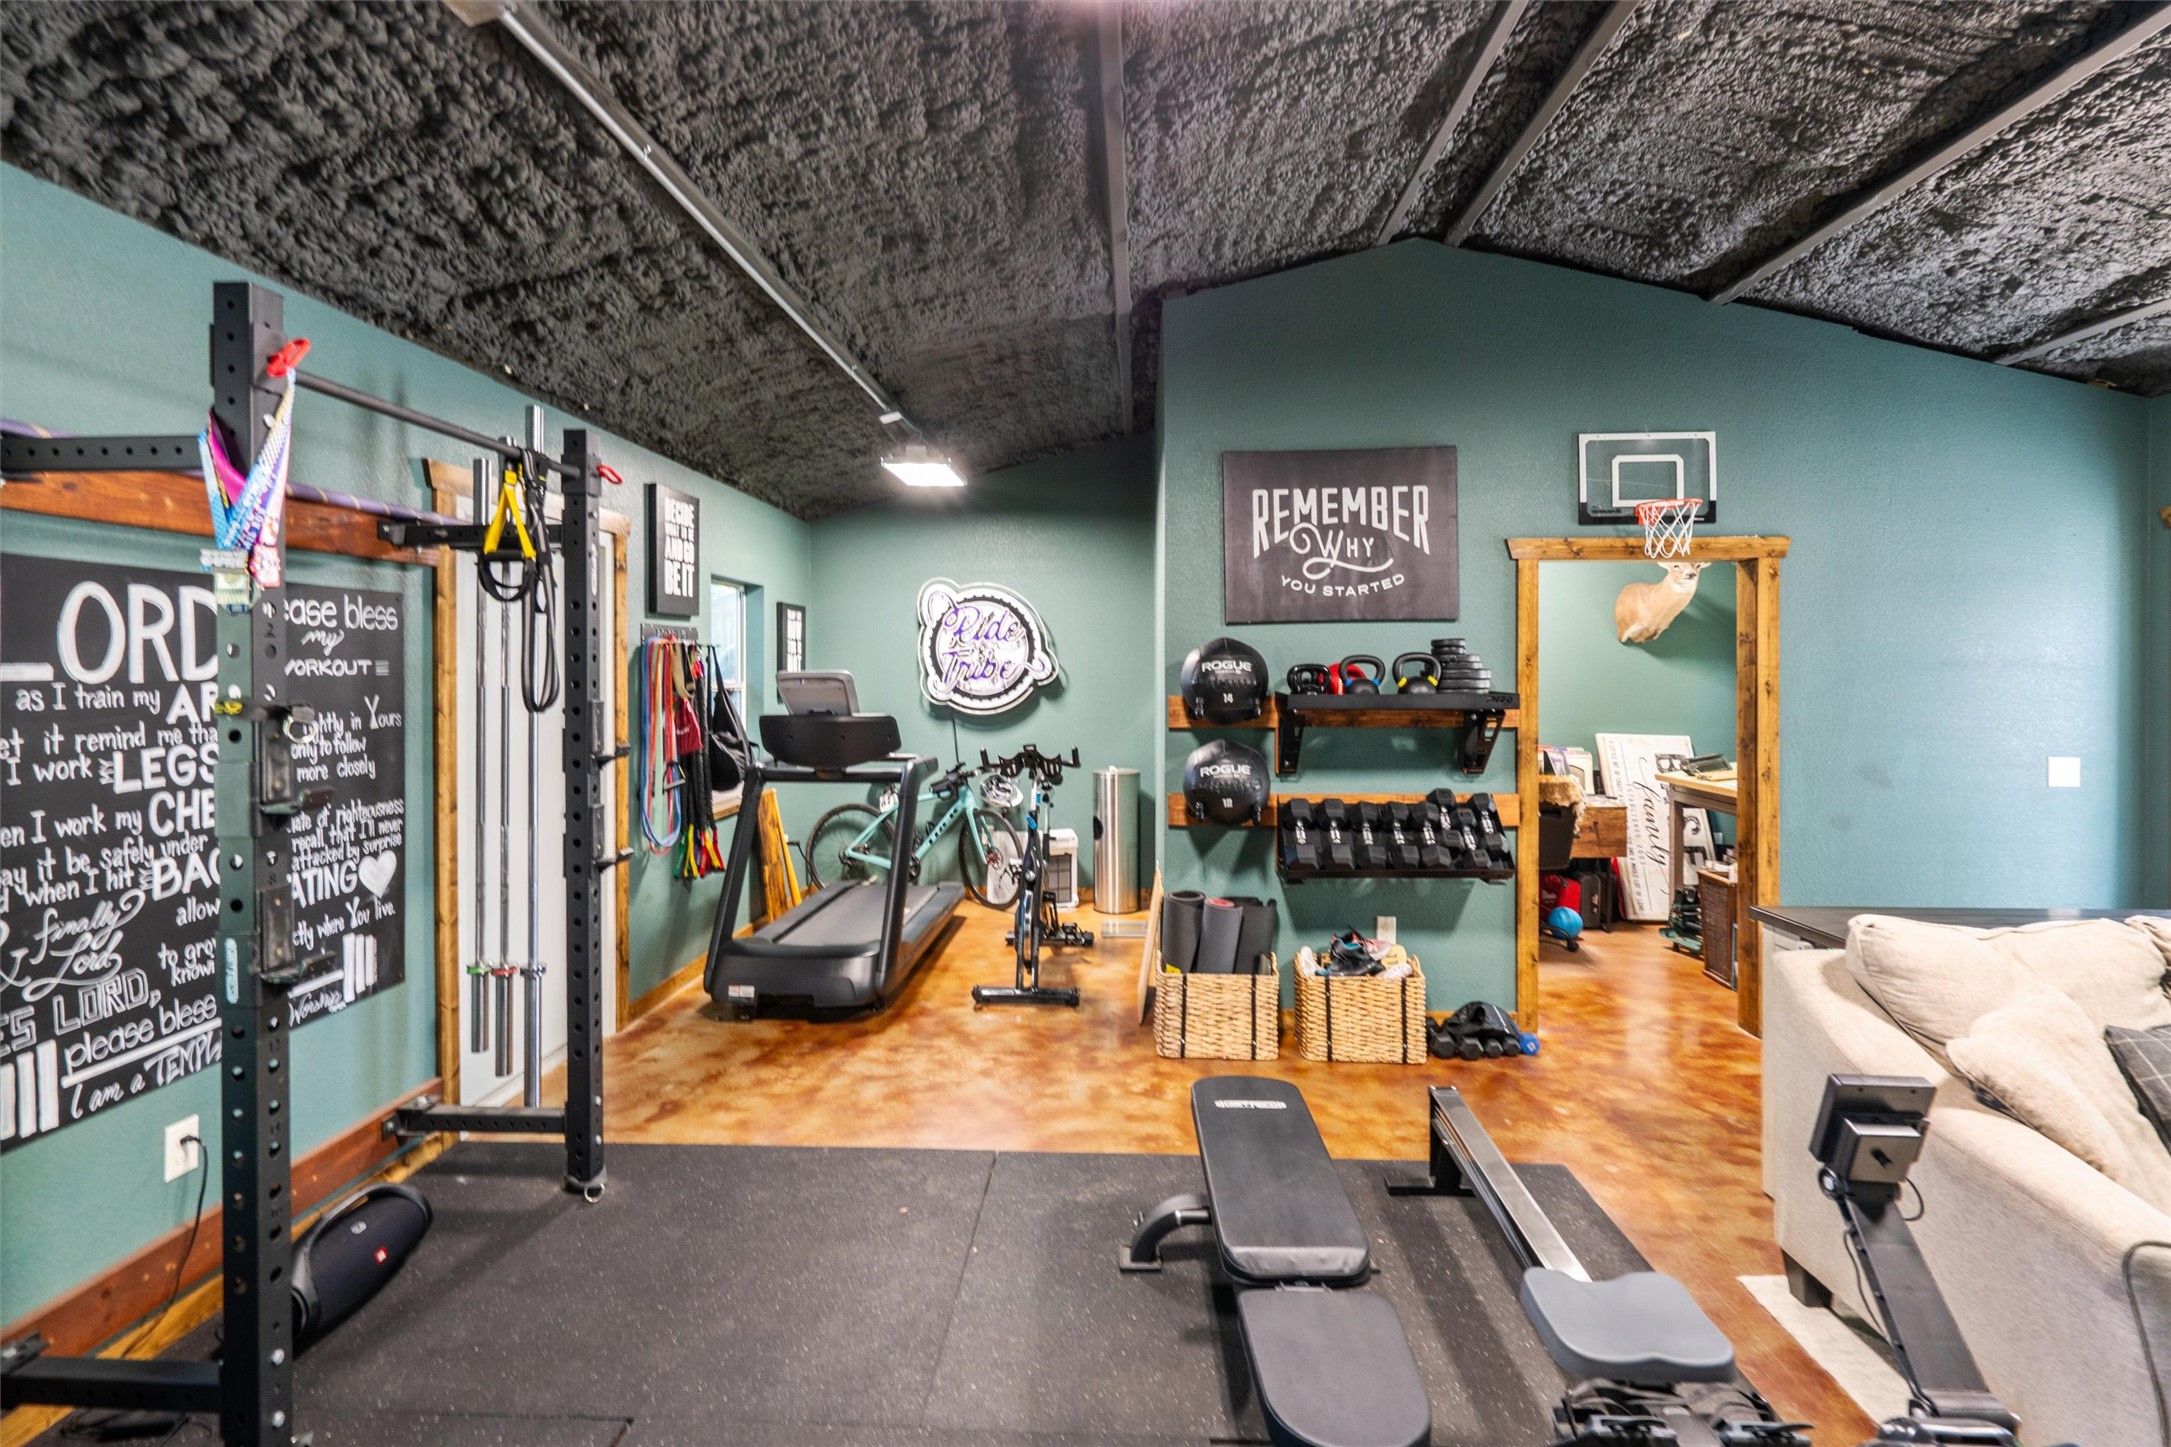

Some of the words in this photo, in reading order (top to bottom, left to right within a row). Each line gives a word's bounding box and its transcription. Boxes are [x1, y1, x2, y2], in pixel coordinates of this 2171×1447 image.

[1252, 485, 1430, 559] REMEMBER
[664, 535, 684, 561] AND
[1289, 522, 1393, 580] WHY
[664, 559, 681, 596] BE
[682, 561, 695, 598] IT
[1281, 575, 1316, 594] YOU
[1322, 573, 1405, 597] STARTED
[283, 598, 337, 628] ase
[344, 593, 398, 630] bless
[938, 600, 1024, 642] Ride
[0, 580, 217, 685] ORD
[301, 629, 345, 656] my
[938, 649, 1028, 689] Tribe
[1201, 660, 1252, 673] ROGUE
[15, 689, 45, 712] as
[51, 682, 67, 710] I
[74, 682, 125, 710] train
[132, 690, 161, 715] my
[350, 711, 362, 730] in
[364, 694, 402, 730] Yours
[43, 722, 64, 755] it
[74, 720, 146, 754] remind
[157, 728, 183, 746] me
[189, 722, 218, 745] tha
[291, 737, 318, 765] only
[319, 732, 333, 756] to
[332, 730, 367, 755] follow
[6, 757, 21, 786] I
[33, 753, 93, 782] work
[296, 763, 329, 783] more
[336, 754, 376, 780] closely
[1200, 764, 1251, 777] ROGUE
[30, 810, 47, 844] I
[54, 803, 107, 838] work
[115, 809, 143, 836] my
[317, 802, 332, 828] of
[336, 798, 405, 828] righteousness
[1633, 757, 1670, 895] family
[37, 847, 57, 881] it
[65, 846, 91, 876] be
[100, 835, 155, 873] safely
[160, 830, 209, 857] under
[291, 826, 325, 853] recall
[329, 823, 356, 846] that
[378, 819, 403, 836] never
[291, 842, 345, 873] attacked
[346, 842, 361, 865] by
[362, 832, 403, 858] surprise
[23, 879, 80, 907] when
[84, 867, 99, 895] I
[106, 867, 135, 892] hit
[286, 859, 358, 909] ATING
[29, 888, 146, 966] finally
[316, 913, 345, 939] where
[345, 895, 370, 930] You
[22, 931, 124, 1003] Lord
[157, 942, 179, 970] to
[64, 1018, 154, 1076] please
[158, 993, 218, 1036] bless
[89, 1082, 124, 1112] am
[130, 1072, 146, 1094] a
[144, 1030, 223, 1087] TEMPL
